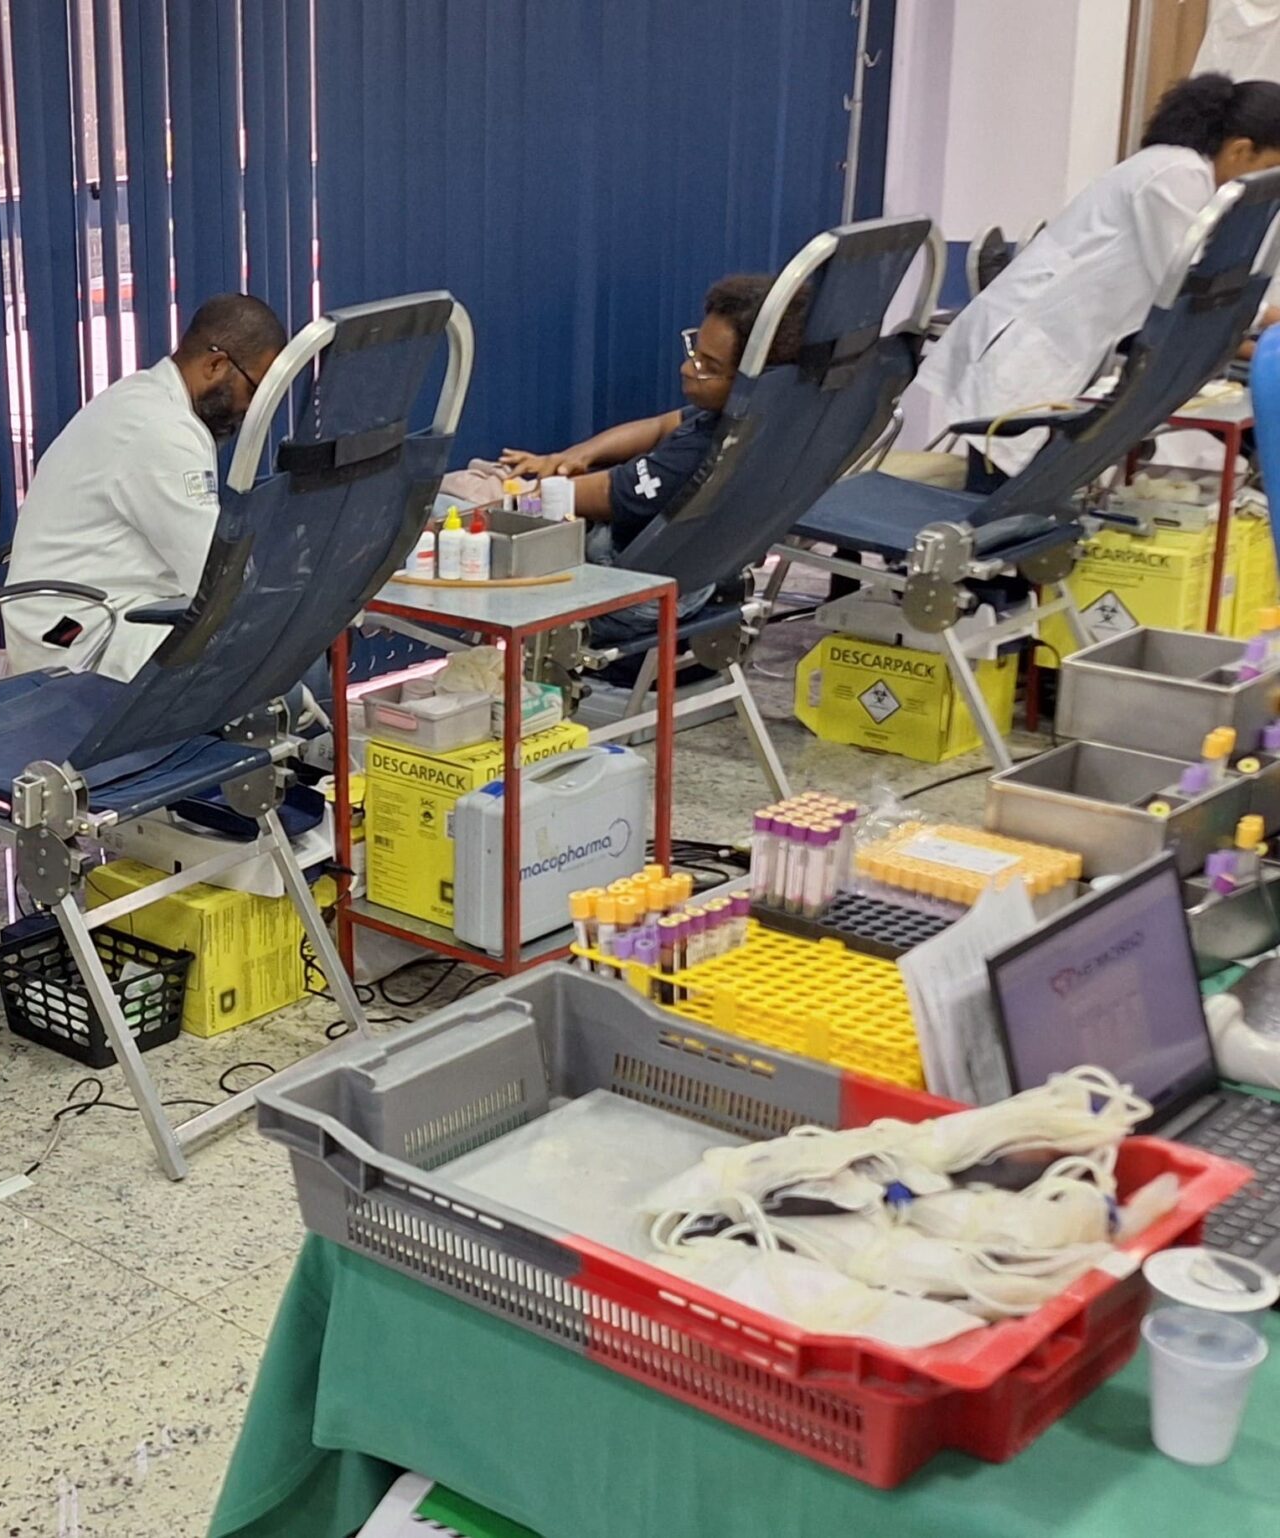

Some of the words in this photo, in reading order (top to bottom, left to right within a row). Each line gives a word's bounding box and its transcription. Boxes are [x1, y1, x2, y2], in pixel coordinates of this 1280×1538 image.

[1091, 546, 1171, 569] CARPACK
[829, 647, 937, 679] DESCARPACK
[372, 753, 467, 791] DESCARPACK
[519, 836, 613, 882] macopharma
